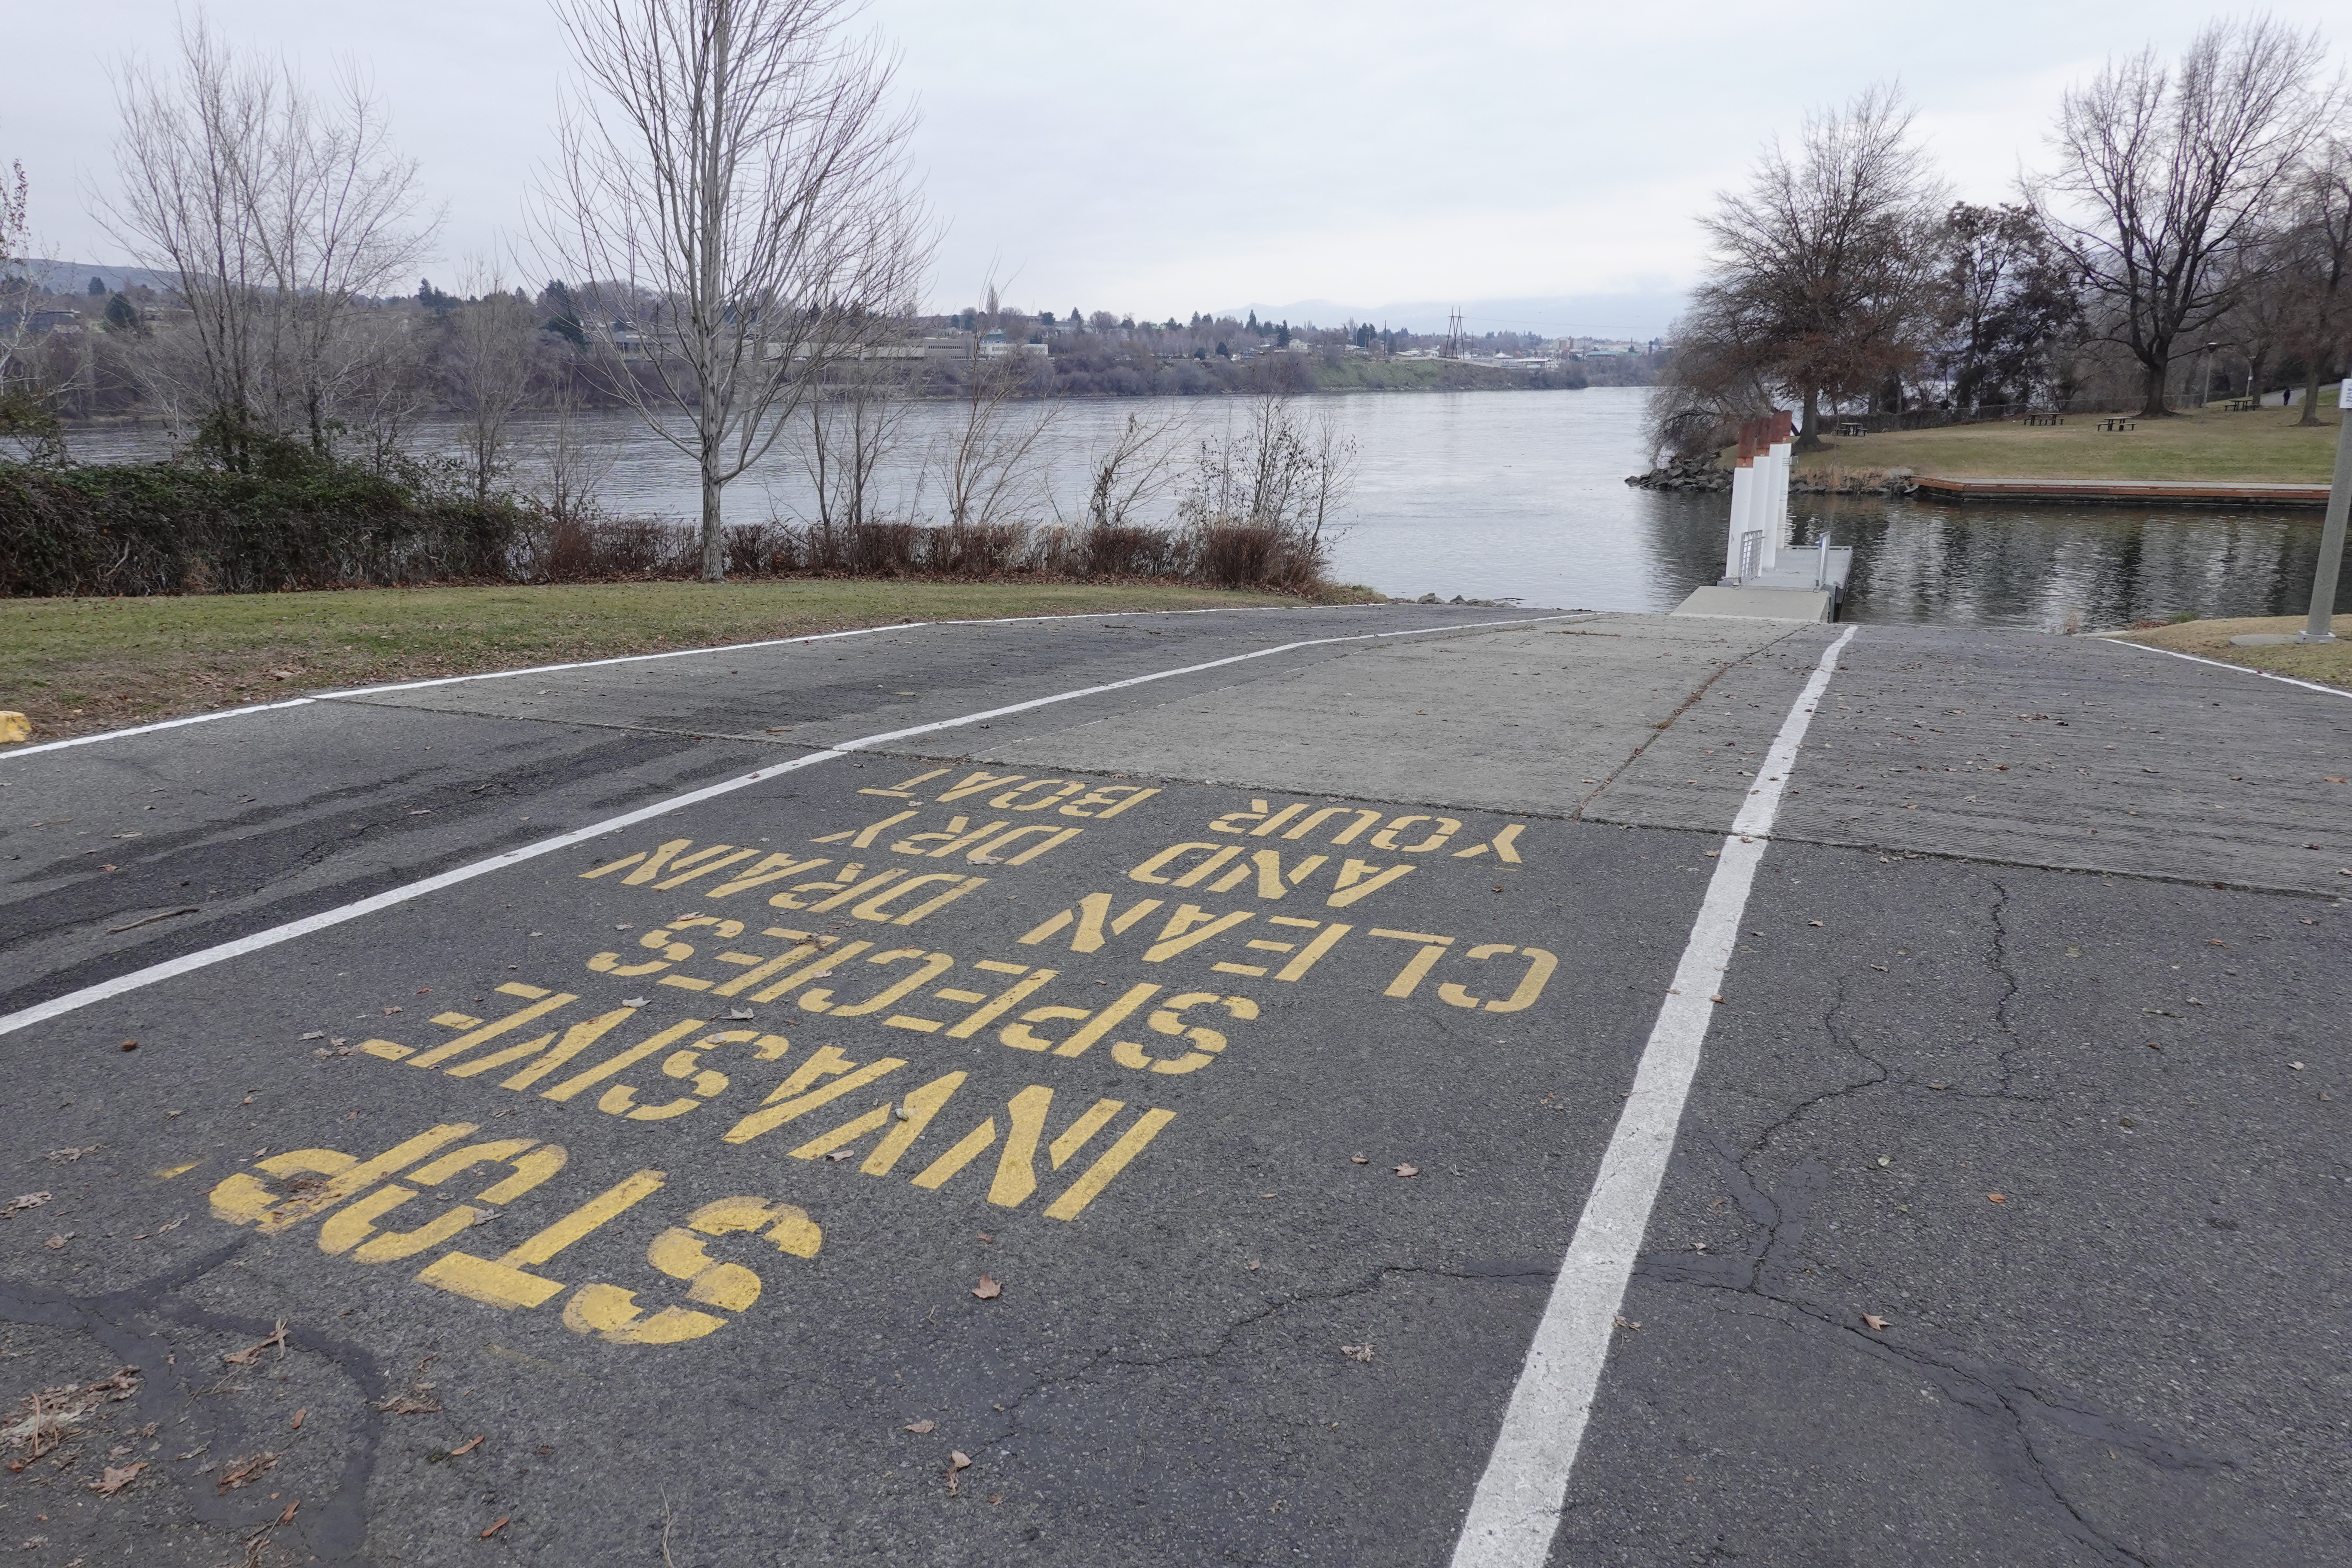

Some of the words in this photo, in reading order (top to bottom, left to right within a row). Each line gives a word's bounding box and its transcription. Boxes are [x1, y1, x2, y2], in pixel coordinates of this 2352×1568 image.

[858, 769, 1162, 818] BOAT
[1209, 798, 1527, 864] YOUR
[578, 838, 989, 925] DRAIN
[810, 810, 1085, 866] DRY
[1129, 842, 1418, 907] AND
[587, 916, 1259, 1076] SPECIES
[1017, 892, 1559, 1013] CLEAN
[362, 982, 1176, 1221] INVASIVE
[209, 1121, 823, 1344] STOP
